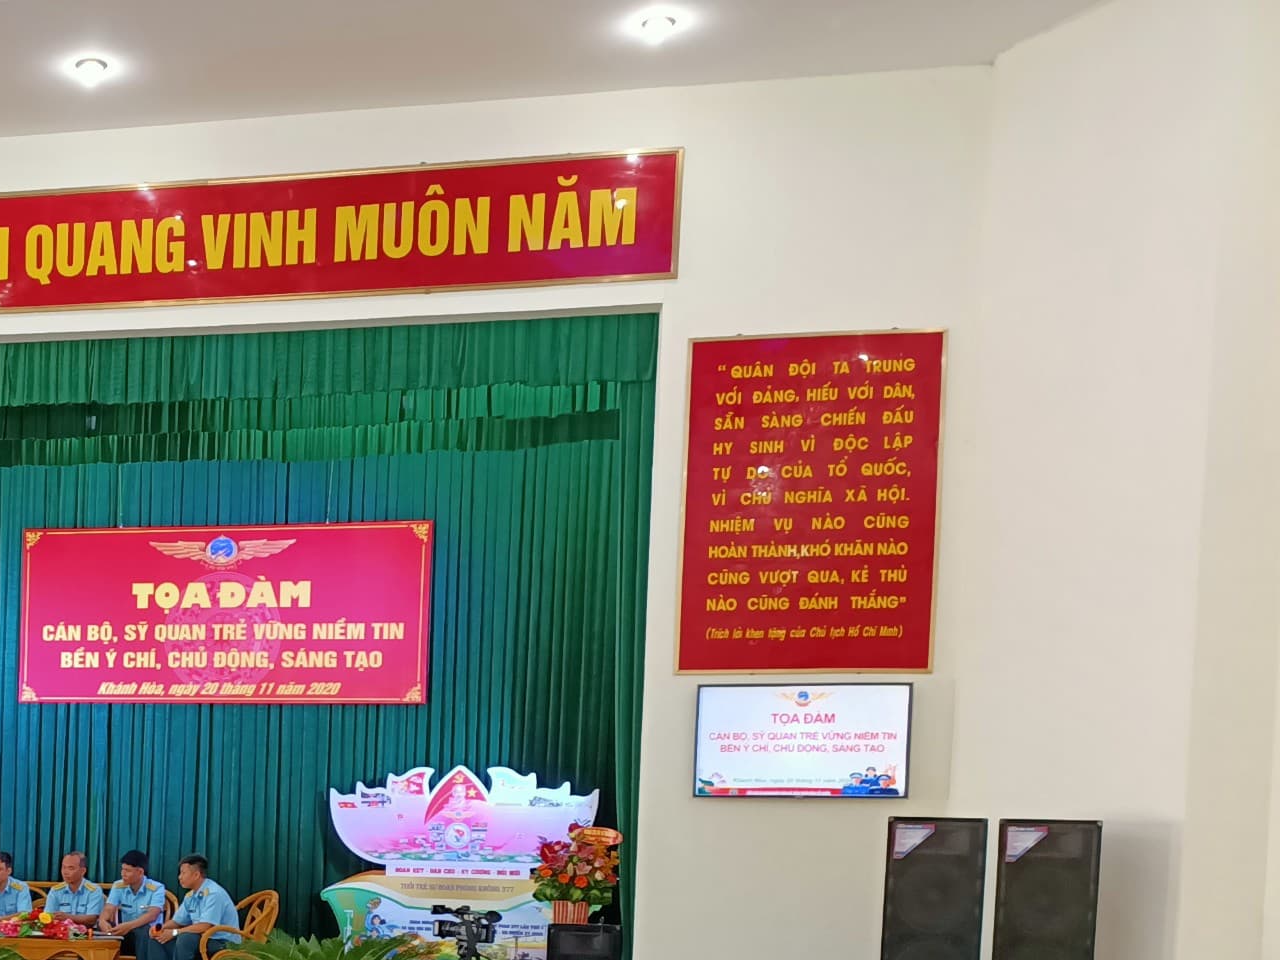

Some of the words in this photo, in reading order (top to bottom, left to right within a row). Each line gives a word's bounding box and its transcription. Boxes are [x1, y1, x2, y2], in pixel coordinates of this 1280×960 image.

[25, 217, 186, 284] QUANG
[201, 207, 317, 270] VINH
[334, 184, 490, 262] MUÔN
[507, 175, 637, 251] NĂM
[789, 359, 815, 379] ĐỘI
[833, 362, 849, 374] TA
[865, 358, 915, 373] TRUNG
[716, 386, 742, 405] VỚI
[752, 385, 799, 404] ĐẢNG,
[807, 381, 838, 401] HIẾU
[848, 381, 873, 400] VỚI
[884, 382, 915, 399] DÂN,
[714, 412, 744, 430] SẴN
[761, 411, 803, 428] SÀNG
[821, 406, 865, 426] CHIẾN
[882, 405, 913, 424] ĐẤU
[713, 443, 732, 455] HY
[750, 441, 784, 454] SINH
[801, 434, 815, 452] VÌ
[833, 434, 868, 453] ĐỘC
[884, 432, 912, 450] LẬP
[713, 466, 731, 483] TỰ
[781, 460, 813, 478] CỦA
[828, 456, 847, 476] TỔ
[861, 457, 911, 477] QUỐC,
[712, 490, 726, 505] VÌ
[785, 487, 832, 503] NGHĨA
[845, 485, 867, 501] XÃ
[710, 517, 755, 534] NHIỆM
[774, 518, 792, 534] VỤ
[812, 513, 845, 530] NÀO
[864, 515, 909, 529] CŨNG
[708, 541, 747, 559] HOÀN
[835, 540, 873, 555] KHĂN
[877, 538, 908, 555] NÀO
[708, 569, 750, 585] CŨNG
[760, 571, 799, 587] VƯỢT
[807, 571, 844, 584] QUA,
[851, 565, 868, 582] KẺ
[880, 565, 907, 582] THÙ
[132, 582, 212, 613] TỌA
[217, 576, 311, 608] ĐÀM
[706, 594, 737, 611] NÀO
[747, 595, 789, 611] CŨNG
[799, 593, 838, 609] ĐÁNH
[42, 622, 83, 641] CÁN
[87, 622, 117, 643] BỘ,
[124, 621, 148, 641] SỸ
[154, 624, 205, 642] QUAN
[212, 618, 246, 640] TRẺ
[253, 618, 306, 640] VỮNG
[313, 618, 365, 639] NIỀM
[372, 622, 404, 639] TIN
[60, 648, 99, 668] BỀN
[105, 648, 117, 668] Ý
[123, 648, 161, 670] CHÍ,
[168, 647, 207, 668] CHỦ
[214, 649, 274, 670] ĐỘNG,
[281, 647, 337, 668] SÁNG
[345, 651, 383, 672] TẠO
[97, 682, 137, 695] Khánh
[139, 682, 165, 695] Hòa,
[168, 684, 198, 696] ngày
[200, 682, 218, 695] 20
[221, 682, 255, 697] tháng
[259, 682, 273, 695] 11
[275, 683, 304, 695] năm
[306, 682, 341, 695] 2020
[771, 714, 800, 726] TỌA
[804, 711, 836, 723] ĐÀM
